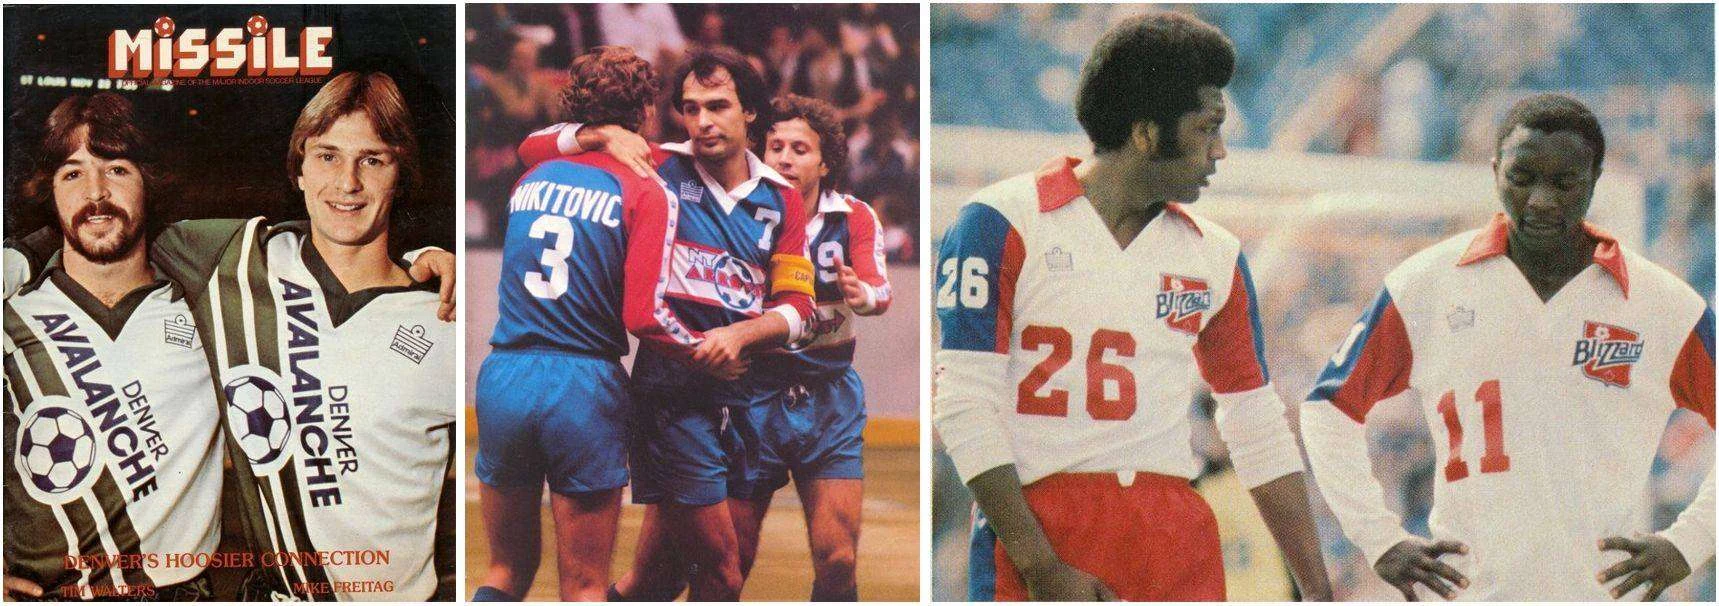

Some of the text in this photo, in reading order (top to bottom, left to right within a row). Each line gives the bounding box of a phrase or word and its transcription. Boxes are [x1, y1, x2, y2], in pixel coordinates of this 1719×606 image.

[509, 180, 623, 228] NIKITOVIC
[754, 207, 781, 251] 7
[524, 214, 574, 300] 3
[818, 241, 844, 283] 9
[937, 257, 989, 309] 26
[278, 277, 343, 509] AVALANCHE
[1016, 324, 1137, 421] 26
[1572, 339, 1645, 367] Blizzard
[32, 313, 159, 503] AVALANCHE
[122, 379, 169, 462] DENVER
[328, 384, 359, 476] DENVER
[1436, 379, 1511, 482] 11
